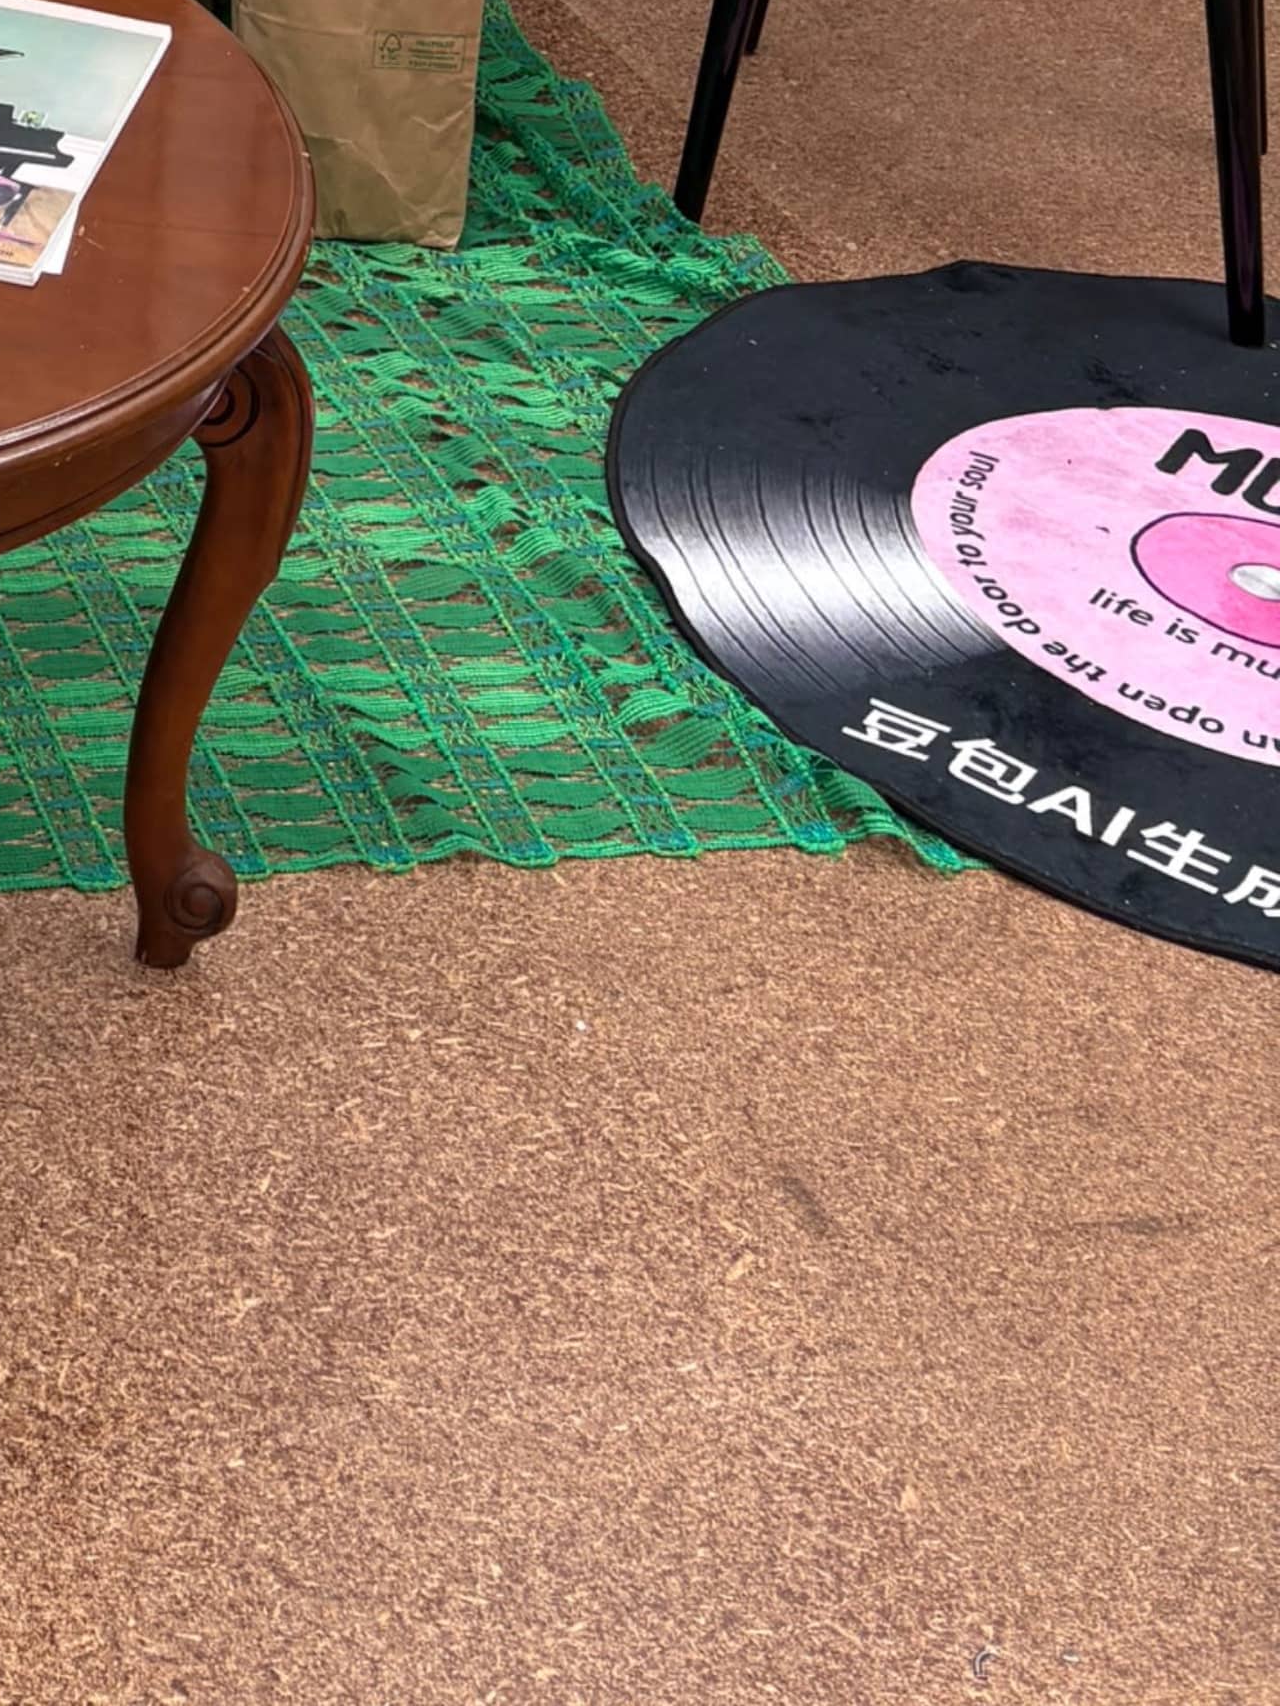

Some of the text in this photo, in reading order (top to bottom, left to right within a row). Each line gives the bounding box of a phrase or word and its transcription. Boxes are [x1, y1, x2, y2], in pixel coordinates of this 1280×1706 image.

[960, 450, 1000, 491] soul
[950, 491, 986, 541] your
[956, 543, 987, 567] to
[973, 574, 1041, 635] door
[1089, 588, 1153, 626] life
[1164, 618, 1200, 645] is
[1042, 641, 1107, 683] the
[1118, 683, 1225, 734] open
